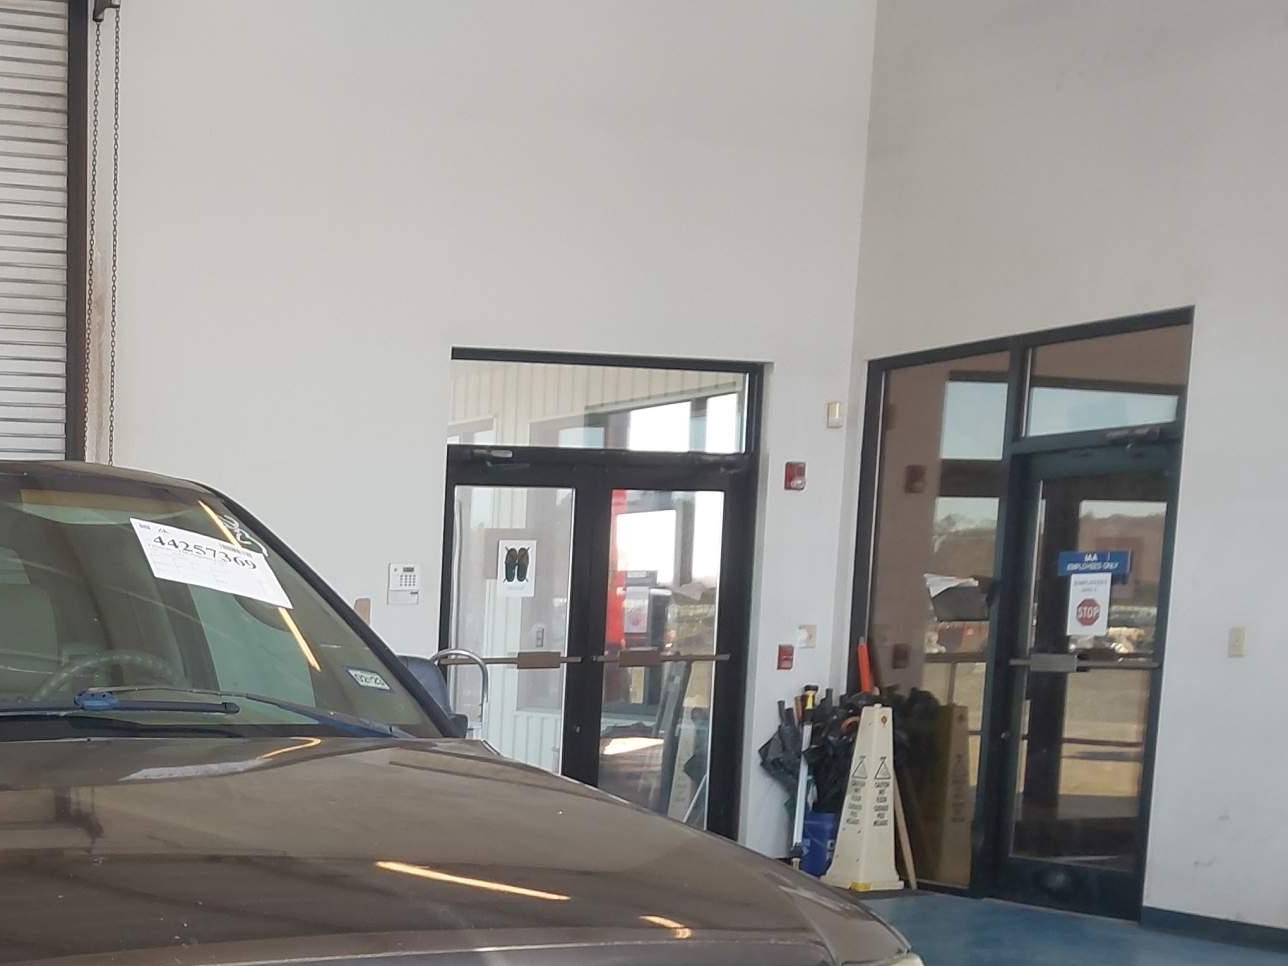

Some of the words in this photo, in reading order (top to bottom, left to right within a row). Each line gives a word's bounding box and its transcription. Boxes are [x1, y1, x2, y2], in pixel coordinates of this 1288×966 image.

[153, 535, 257, 570] 44257369
[1084, 553, 1098, 561] IAA
[1078, 605, 1099, 618] STOP
